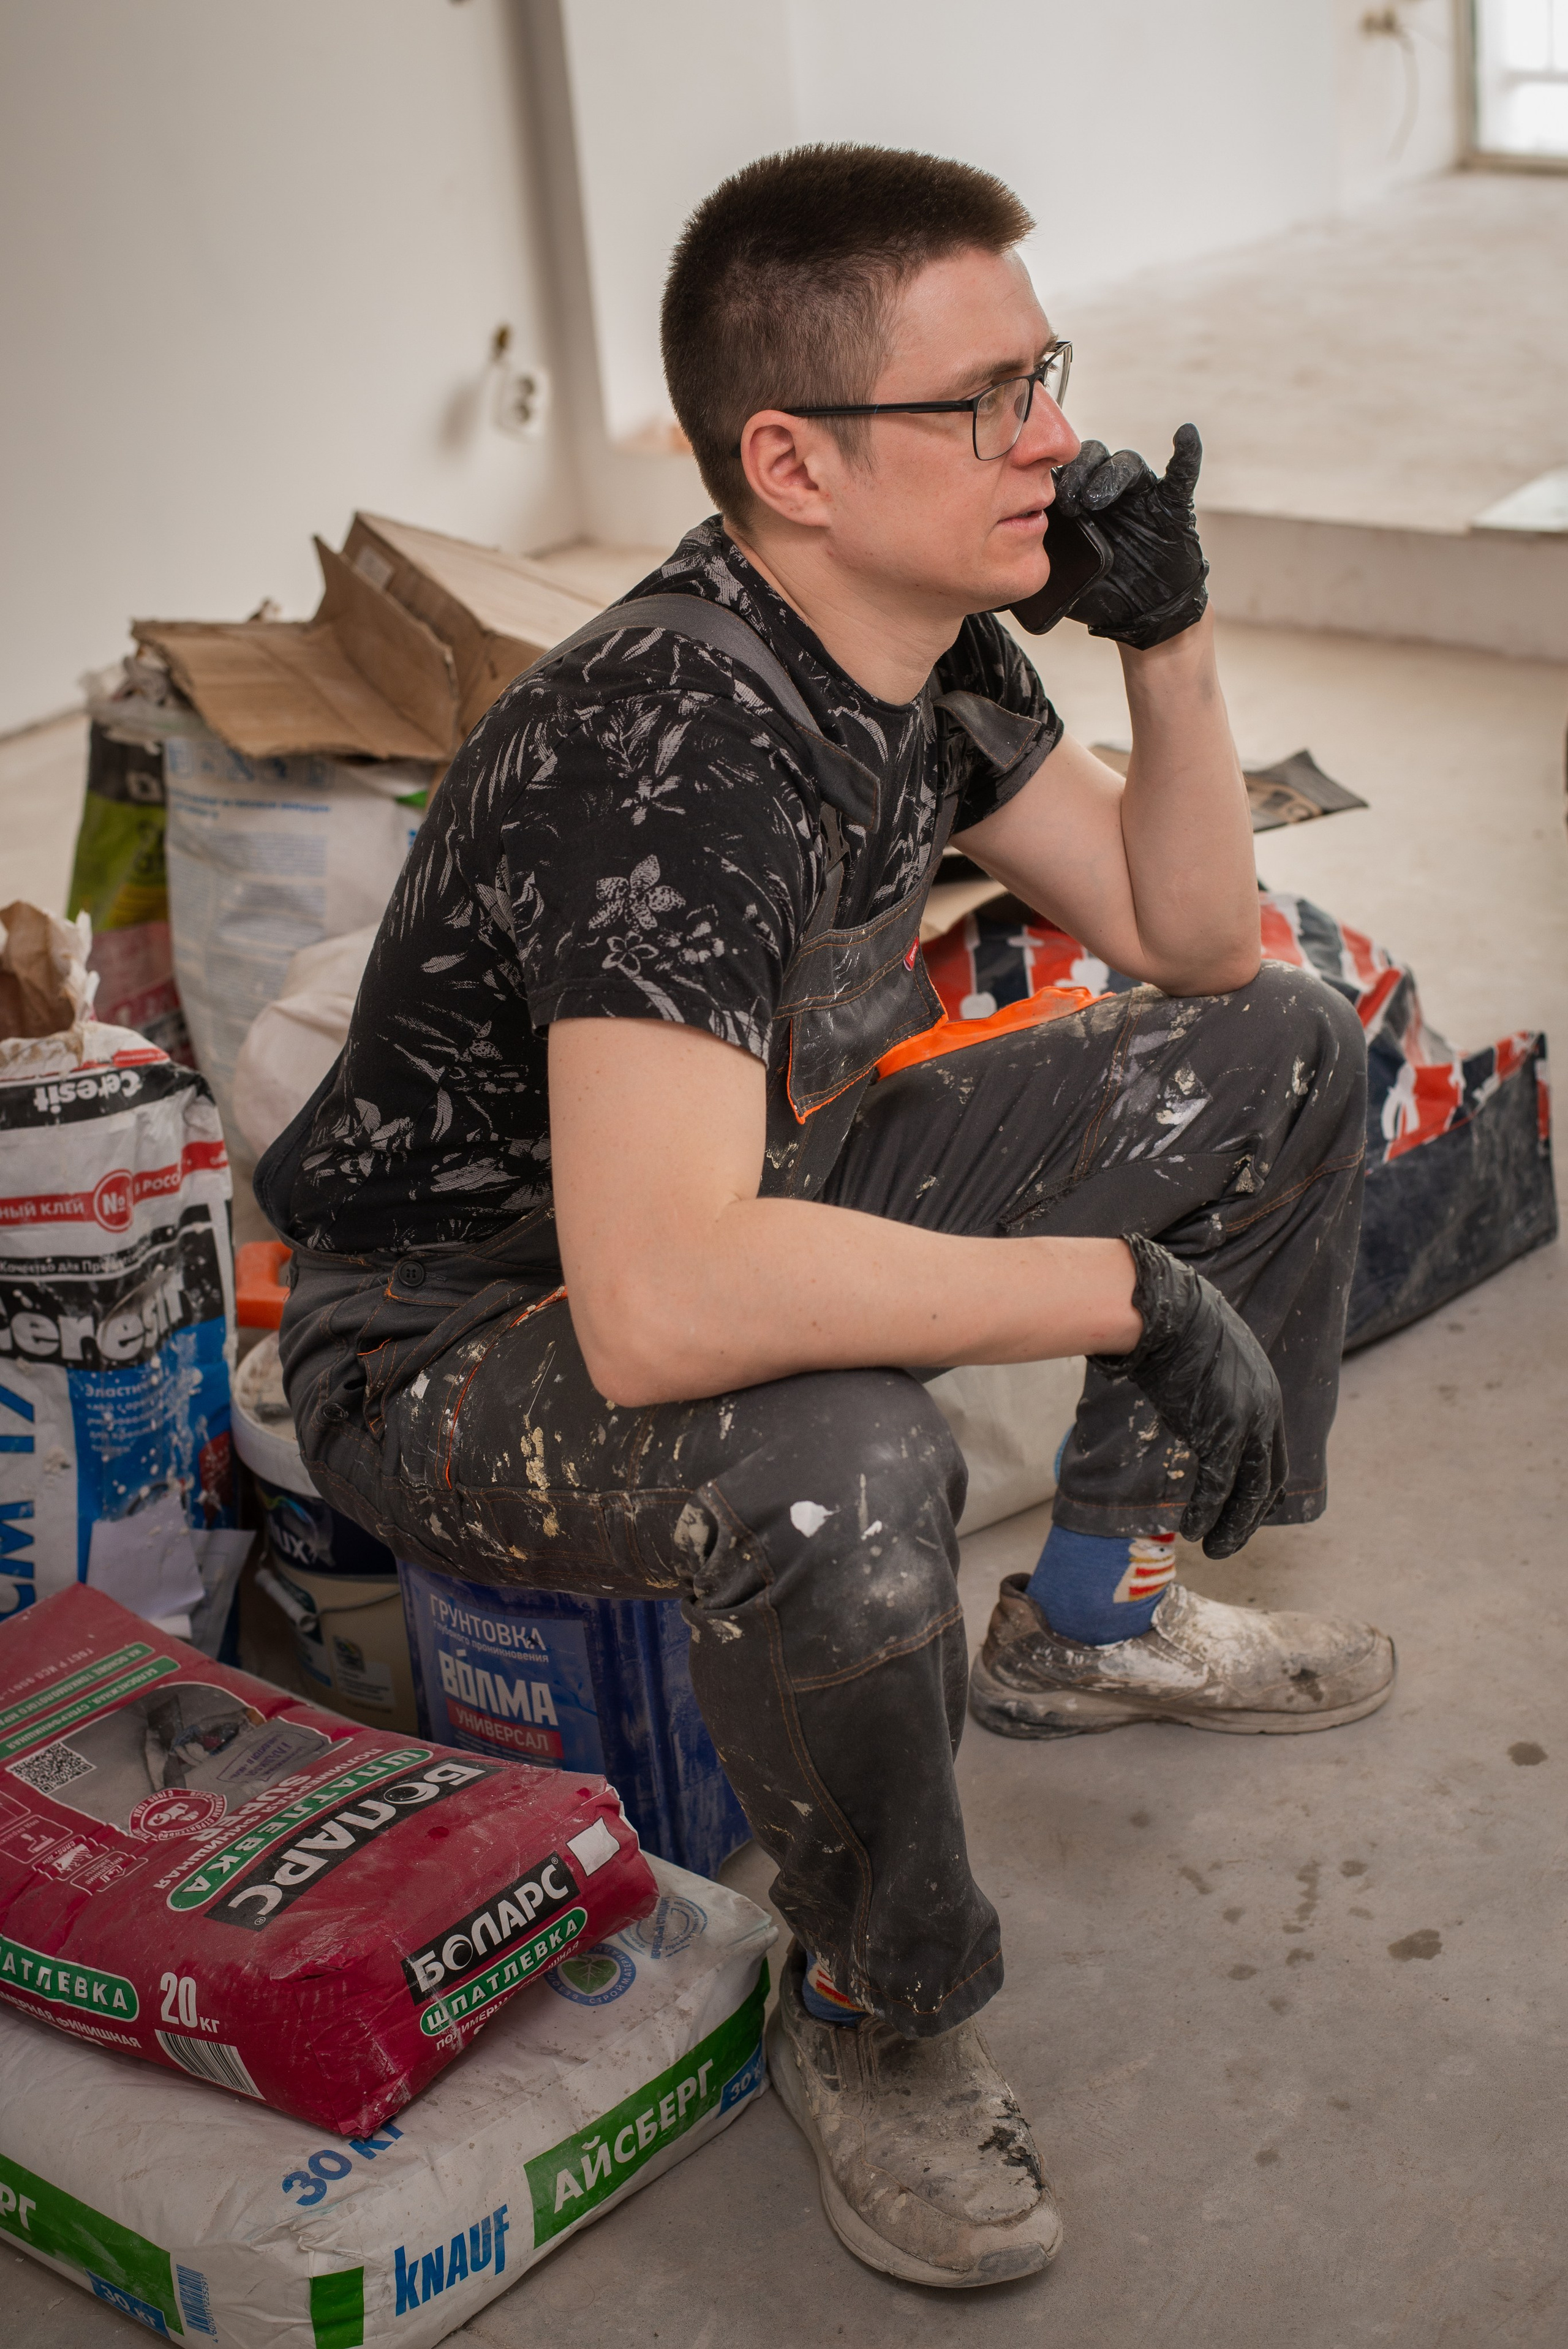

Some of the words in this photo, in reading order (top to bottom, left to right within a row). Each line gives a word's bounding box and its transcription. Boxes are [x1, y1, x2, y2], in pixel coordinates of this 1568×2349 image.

[34, 1070, 143, 1114] Ceresit
[40, 1197, 85, 1216] КЛЕЙ
[430, 1593, 546, 1651] ГРУНТОВКА
[472, 1639, 549, 1663] проникновения
[455, 1706, 549, 1751] УНИВЕРСАЛ
[188, 1773, 306, 1846] SUPER
[262, 1747, 382, 1817] ПОЛИМЕРНАЯ
[181, 1751, 422, 1893] ШПАТЛЕВКА
[228, 1763, 486, 1917] БОЛАРС
[85, 1855, 124, 1885] внутренние
[153, 1814, 261, 1891] ФИНИШНАЯ
[417, 1866, 569, 1993] БОЛАРС
[0, 1950, 128, 2012] АТЛЕВКА
[160, 1972, 198, 2027] 20
[426, 1919, 578, 2031] ШПАТЛЕВКА
[56, 2017, 141, 2049] ФИНИШНАЯ
[731, 2076, 750, 2103] 30
[553, 2059, 713, 2214] АЙСБЕРГ
[282, 2150, 352, 2205] 30
[394, 2204, 509, 2317] KNAUF
[100, 2282, 130, 2313] 30
